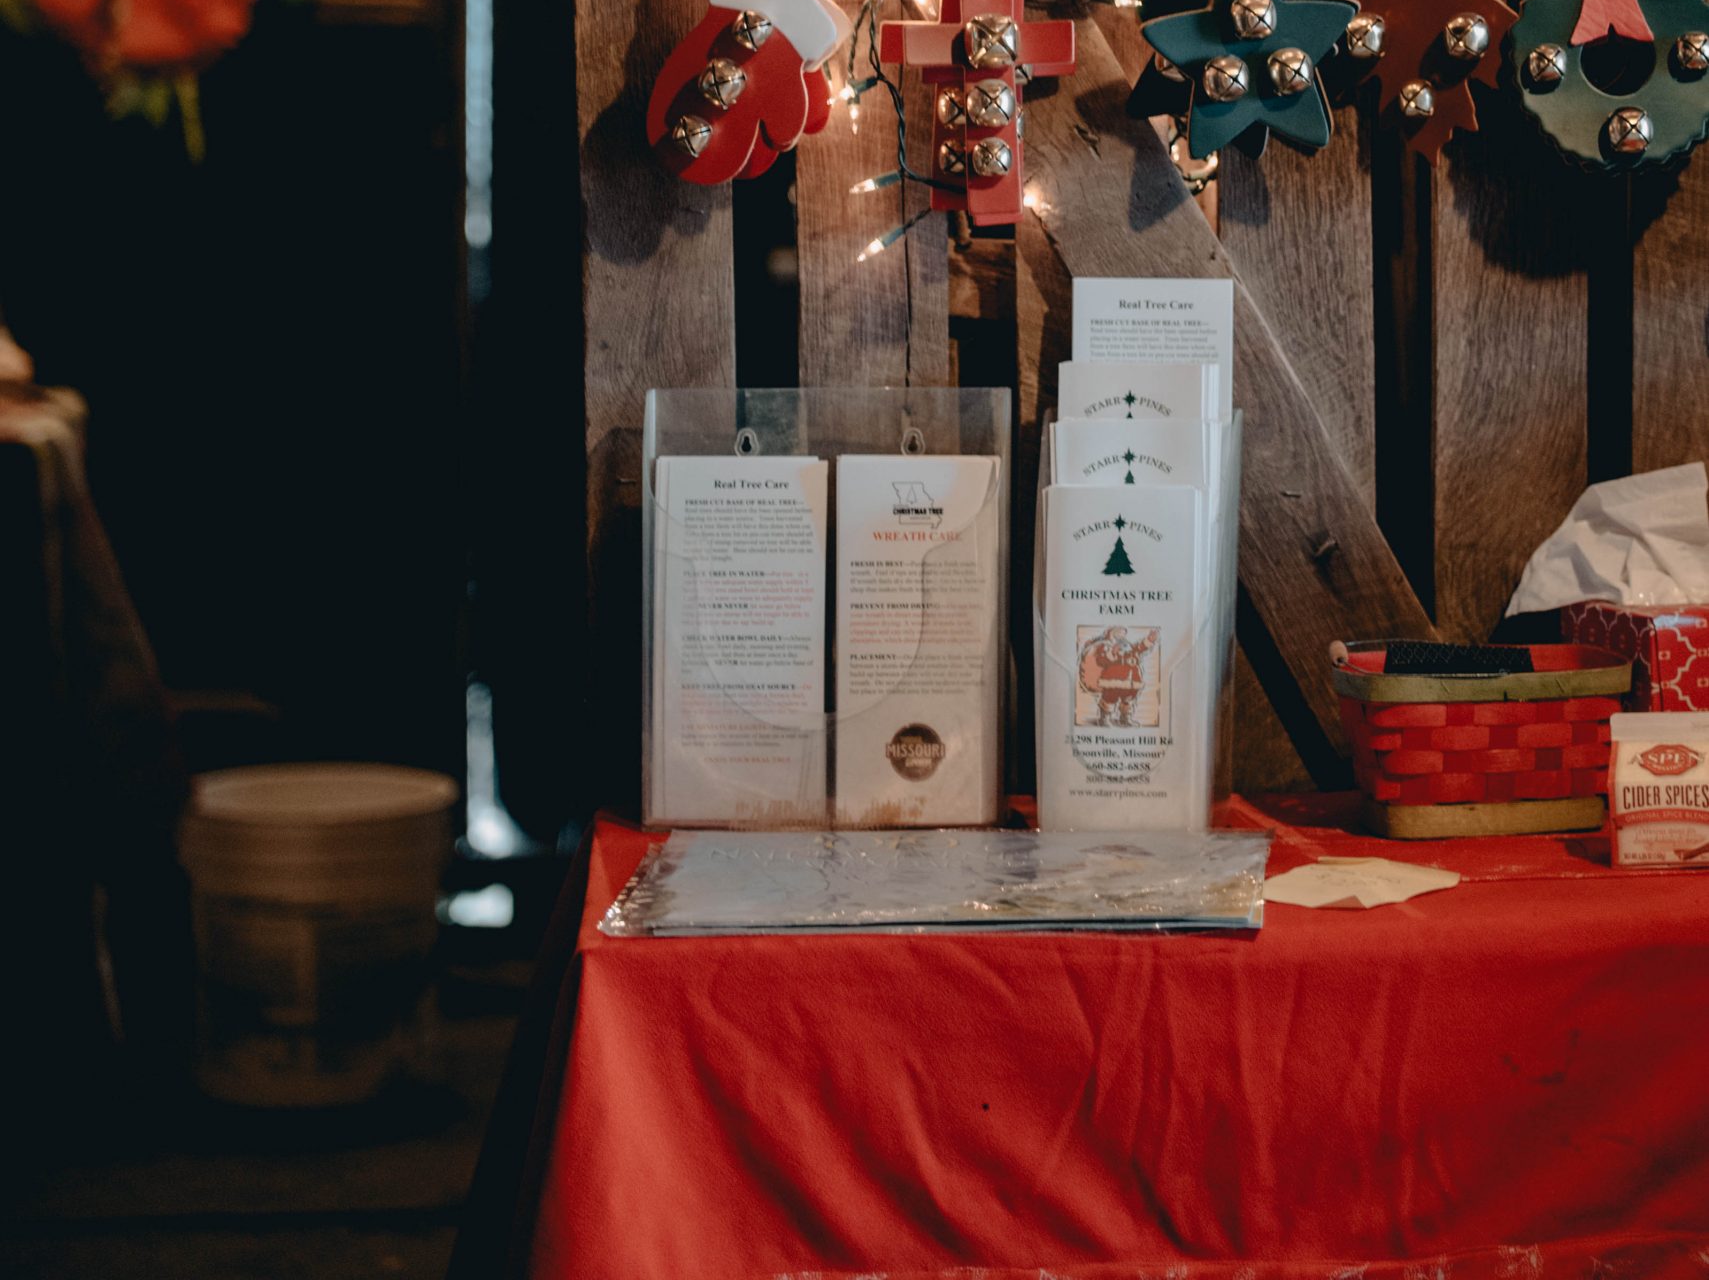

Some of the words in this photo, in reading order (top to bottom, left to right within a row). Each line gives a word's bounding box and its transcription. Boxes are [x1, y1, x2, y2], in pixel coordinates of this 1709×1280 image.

[1118, 299, 1141, 310] Real
[1144, 299, 1166, 310] Tree
[1169, 299, 1194, 310] Care
[1084, 396, 1121, 417] STARR
[1139, 396, 1172, 417] PINES
[1082, 454, 1119, 476] STARR
[1139, 454, 1173, 474] PINES
[713, 479, 736, 490] Real
[740, 479, 762, 490] Tree
[764, 479, 790, 490] Care
[893, 507, 927, 516] CHRISTMAS
[928, 507, 944, 516] TREE
[872, 531, 926, 541] WREATH
[929, 531, 962, 542] CARE
[1073, 520, 1111, 542] STARR
[1129, 521, 1164, 542] PINES
[1061, 589, 1136, 600] CHRISTMAS
[1139, 590, 1173, 601] TREE
[1099, 605, 1135, 615] FARM
[1095, 735, 1135, 745] Pleasant
[1138, 735, 1156, 745] Hill
[886, 743, 945, 757] MISSOURI
[1630, 751, 1706, 766] ASPEN
[1069, 788, 1168, 800] www.starrpines.com
[1623, 785, 1661, 810] CIDER
[1666, 783, 1709, 809] SPICES
